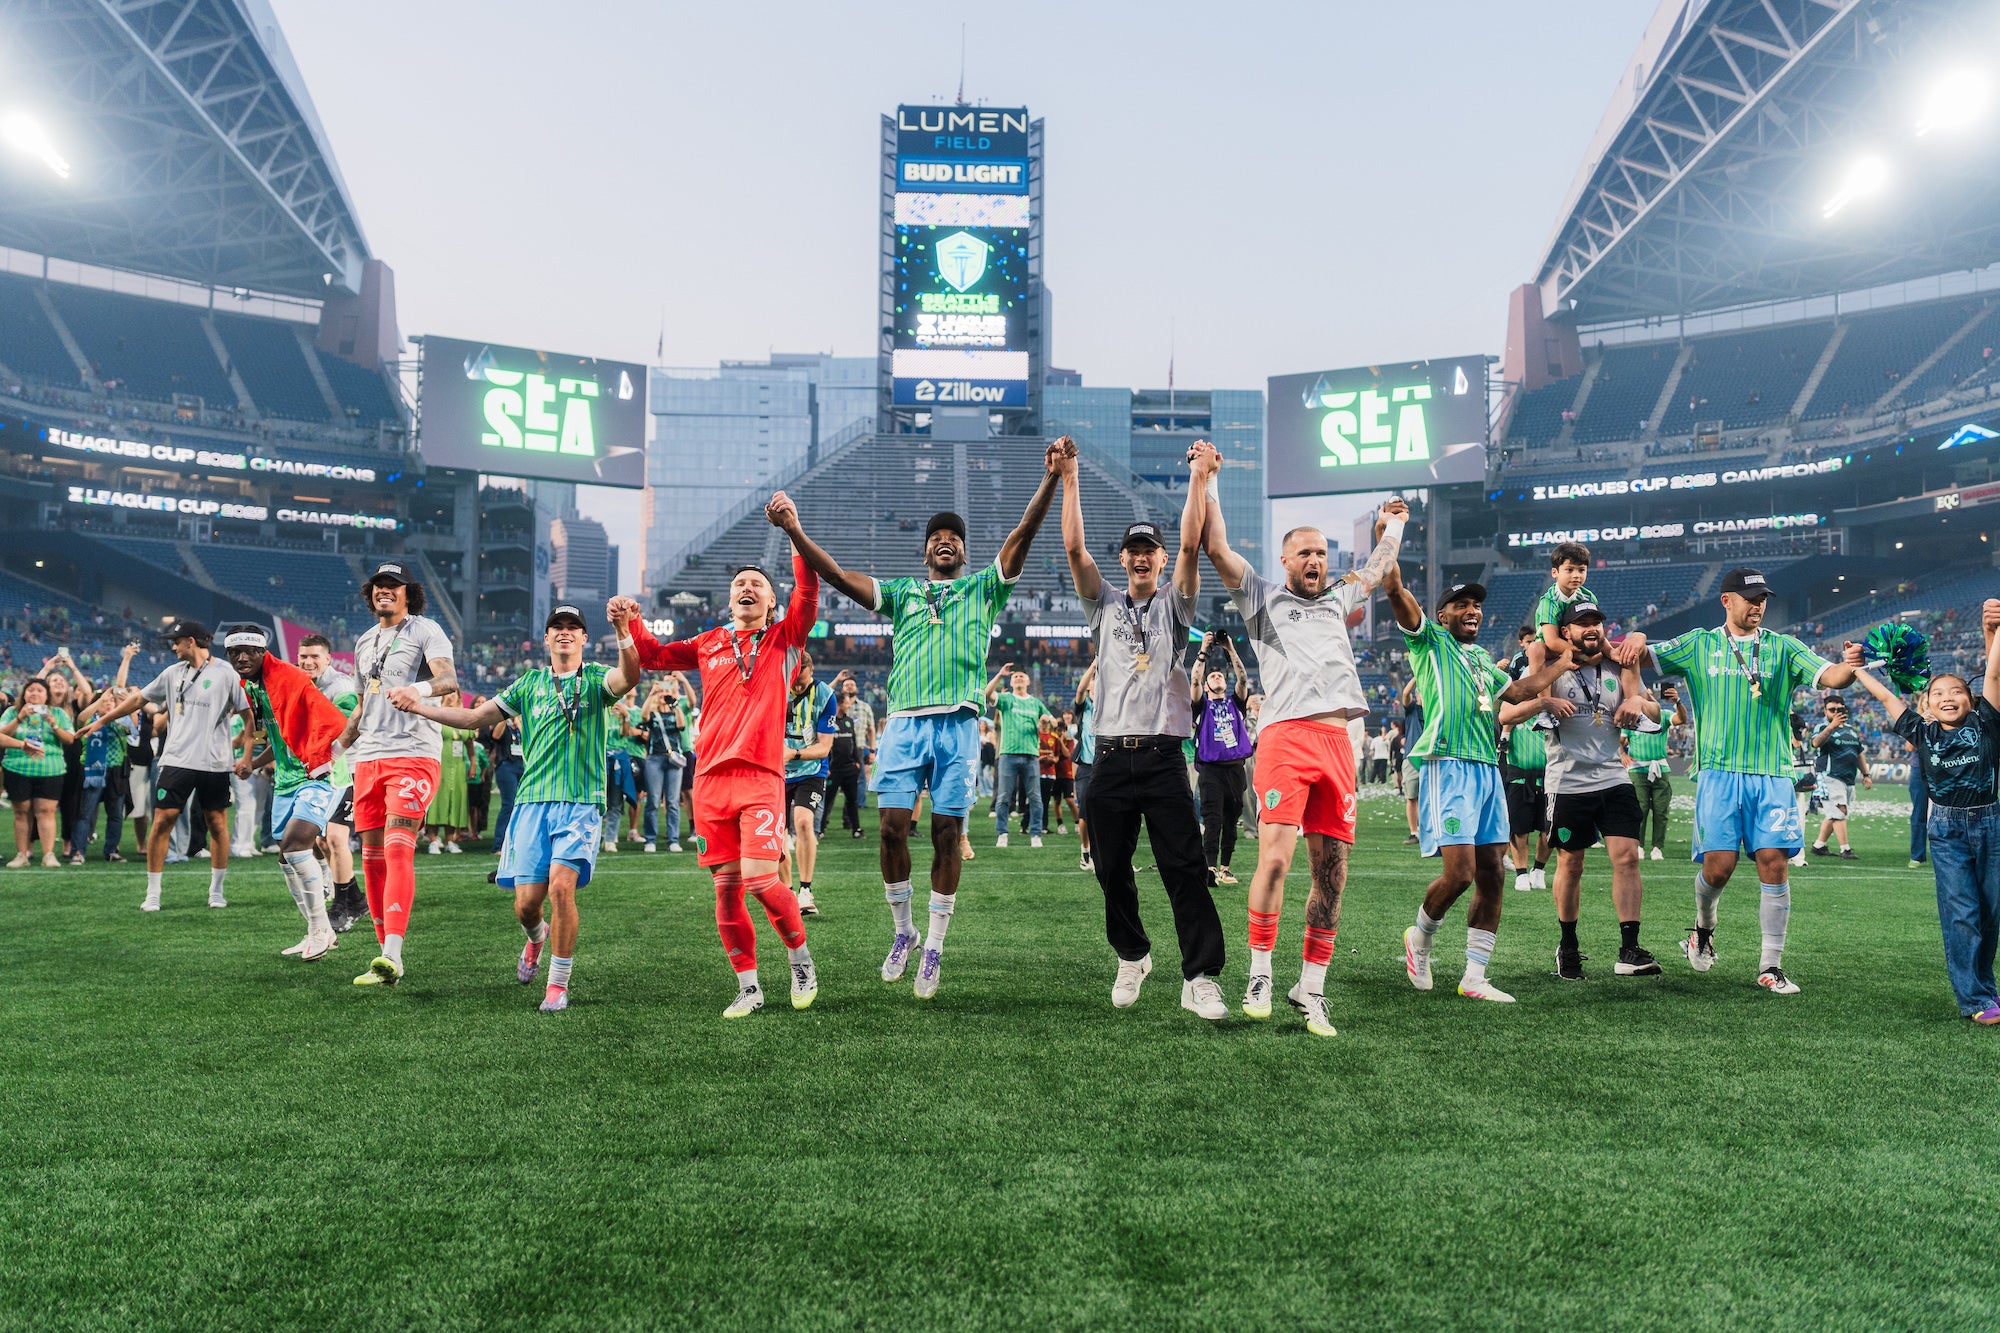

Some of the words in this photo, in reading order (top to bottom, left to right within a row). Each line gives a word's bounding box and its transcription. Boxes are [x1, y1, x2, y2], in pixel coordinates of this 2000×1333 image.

[899, 111, 1026, 133] LUMEN
[934, 136, 991, 150] FIELD
[904, 163, 953, 181] BUD
[954, 164, 1021, 183] LIGHT
[921, 293, 999, 304] SEATTLE
[916, 335, 1006, 346] CHAMPIONS
[938, 381, 1005, 402] Zillow
[481, 367, 599, 457] SEA
[1320, 384, 1432, 468] SEA
[61, 431, 150, 458] LEAGUES
[151, 445, 196, 463] CUP
[250, 457, 376, 482] CHAMPIONS
[1548, 480, 1629, 499] LEAGUES
[1630, 477, 1668, 492] CUP
[1721, 457, 1843, 483] CAMPEONES
[85, 488, 177, 512] LEAGUES
[178, 497, 220, 515] CUP
[276, 509, 397, 530] CHAMPIONS
[1936, 493, 1959, 510] EQC
[1522, 529, 1599, 546] LEAGUES
[1600, 526, 1638, 541] CUP
[1693, 513, 1819, 534] CHAMPIONS
[1063, 597, 1084, 611] FINA
[834, 623, 882, 636] SOUNDERS
[1025, 625, 1052, 638] INTER
[1052, 625, 1082, 638] MIAMI
[1567, 688, 1576, 699] 6
[1941, 754, 1980, 769] rovidenc
[398, 777, 431, 802] 29
[755, 809, 785, 839] 26
[1770, 806, 1799, 832] 25
